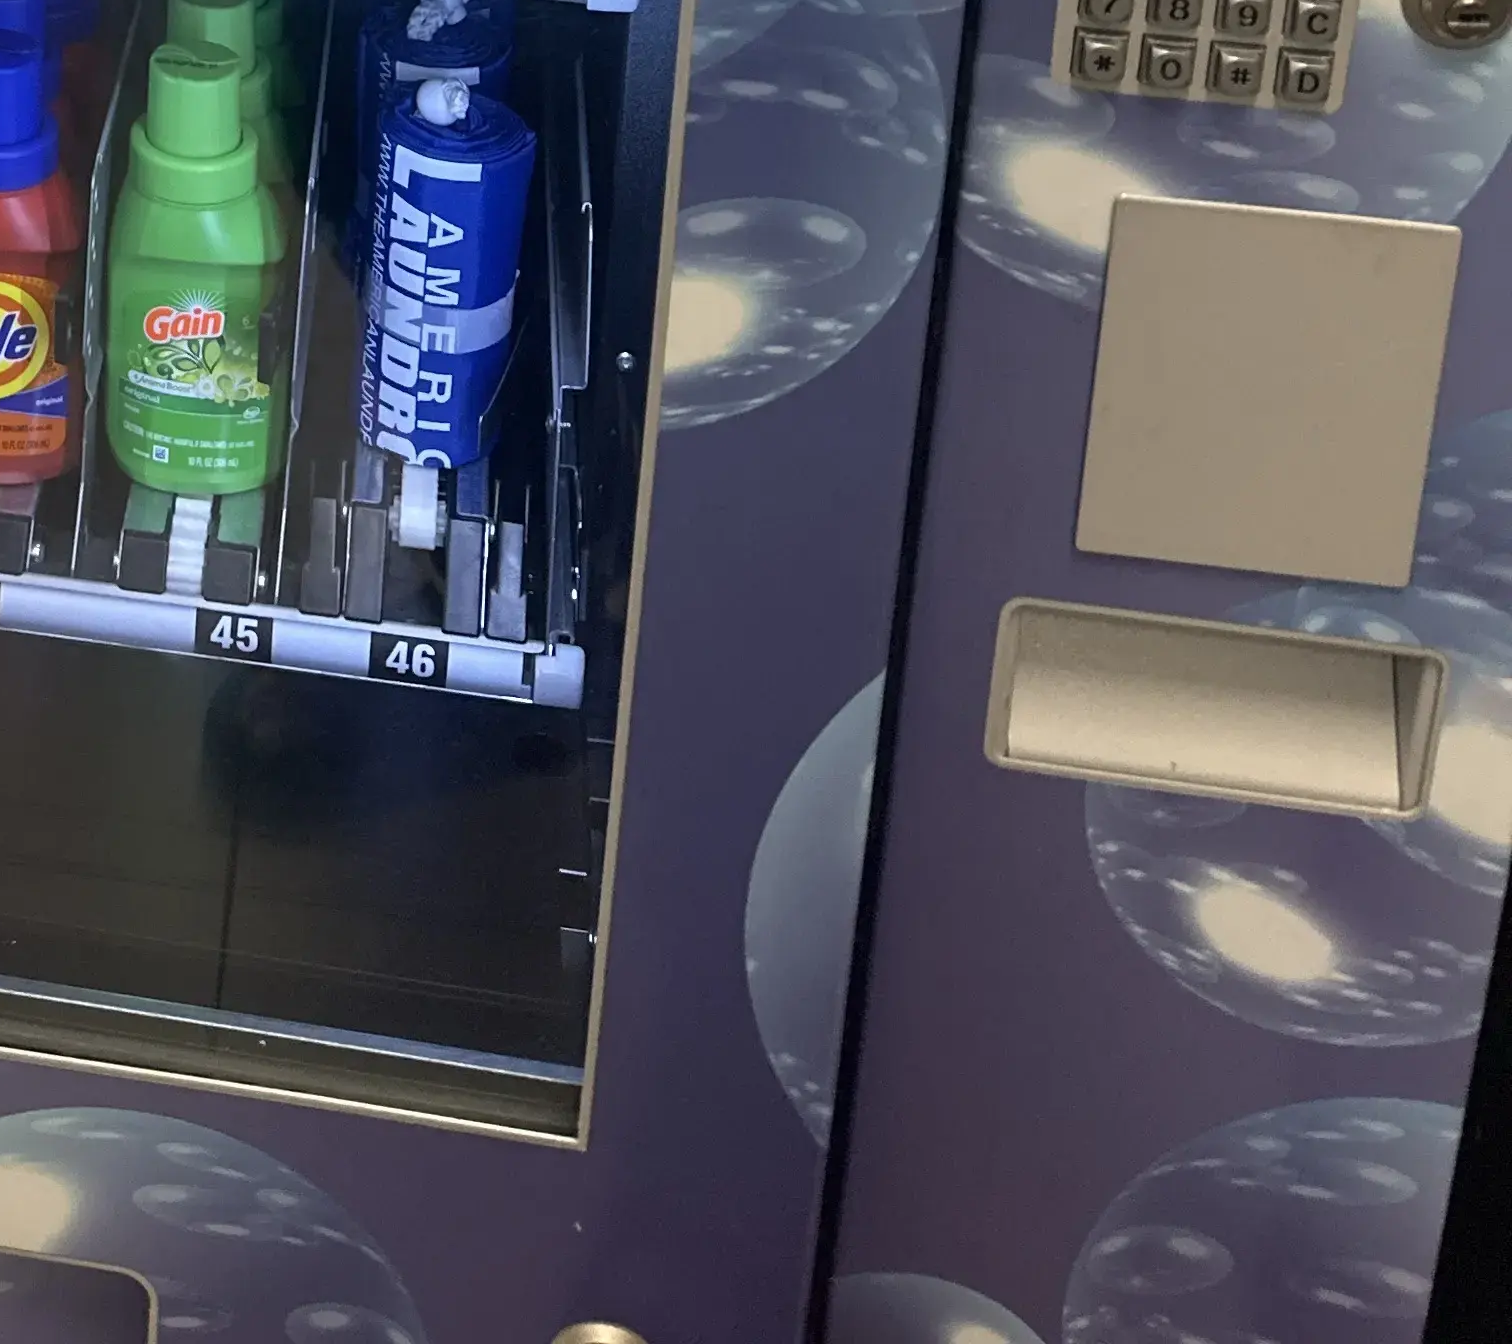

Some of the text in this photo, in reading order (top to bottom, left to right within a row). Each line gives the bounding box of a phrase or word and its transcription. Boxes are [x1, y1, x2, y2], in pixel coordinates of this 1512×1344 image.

[1238, 4, 1259, 28] 9
[1307, 11, 1330, 35] C
[1298, 71, 1320, 95] D
[144, 306, 225, 344] Gain
[210, 616, 259, 653] 45
[386, 642, 435, 678] 46
